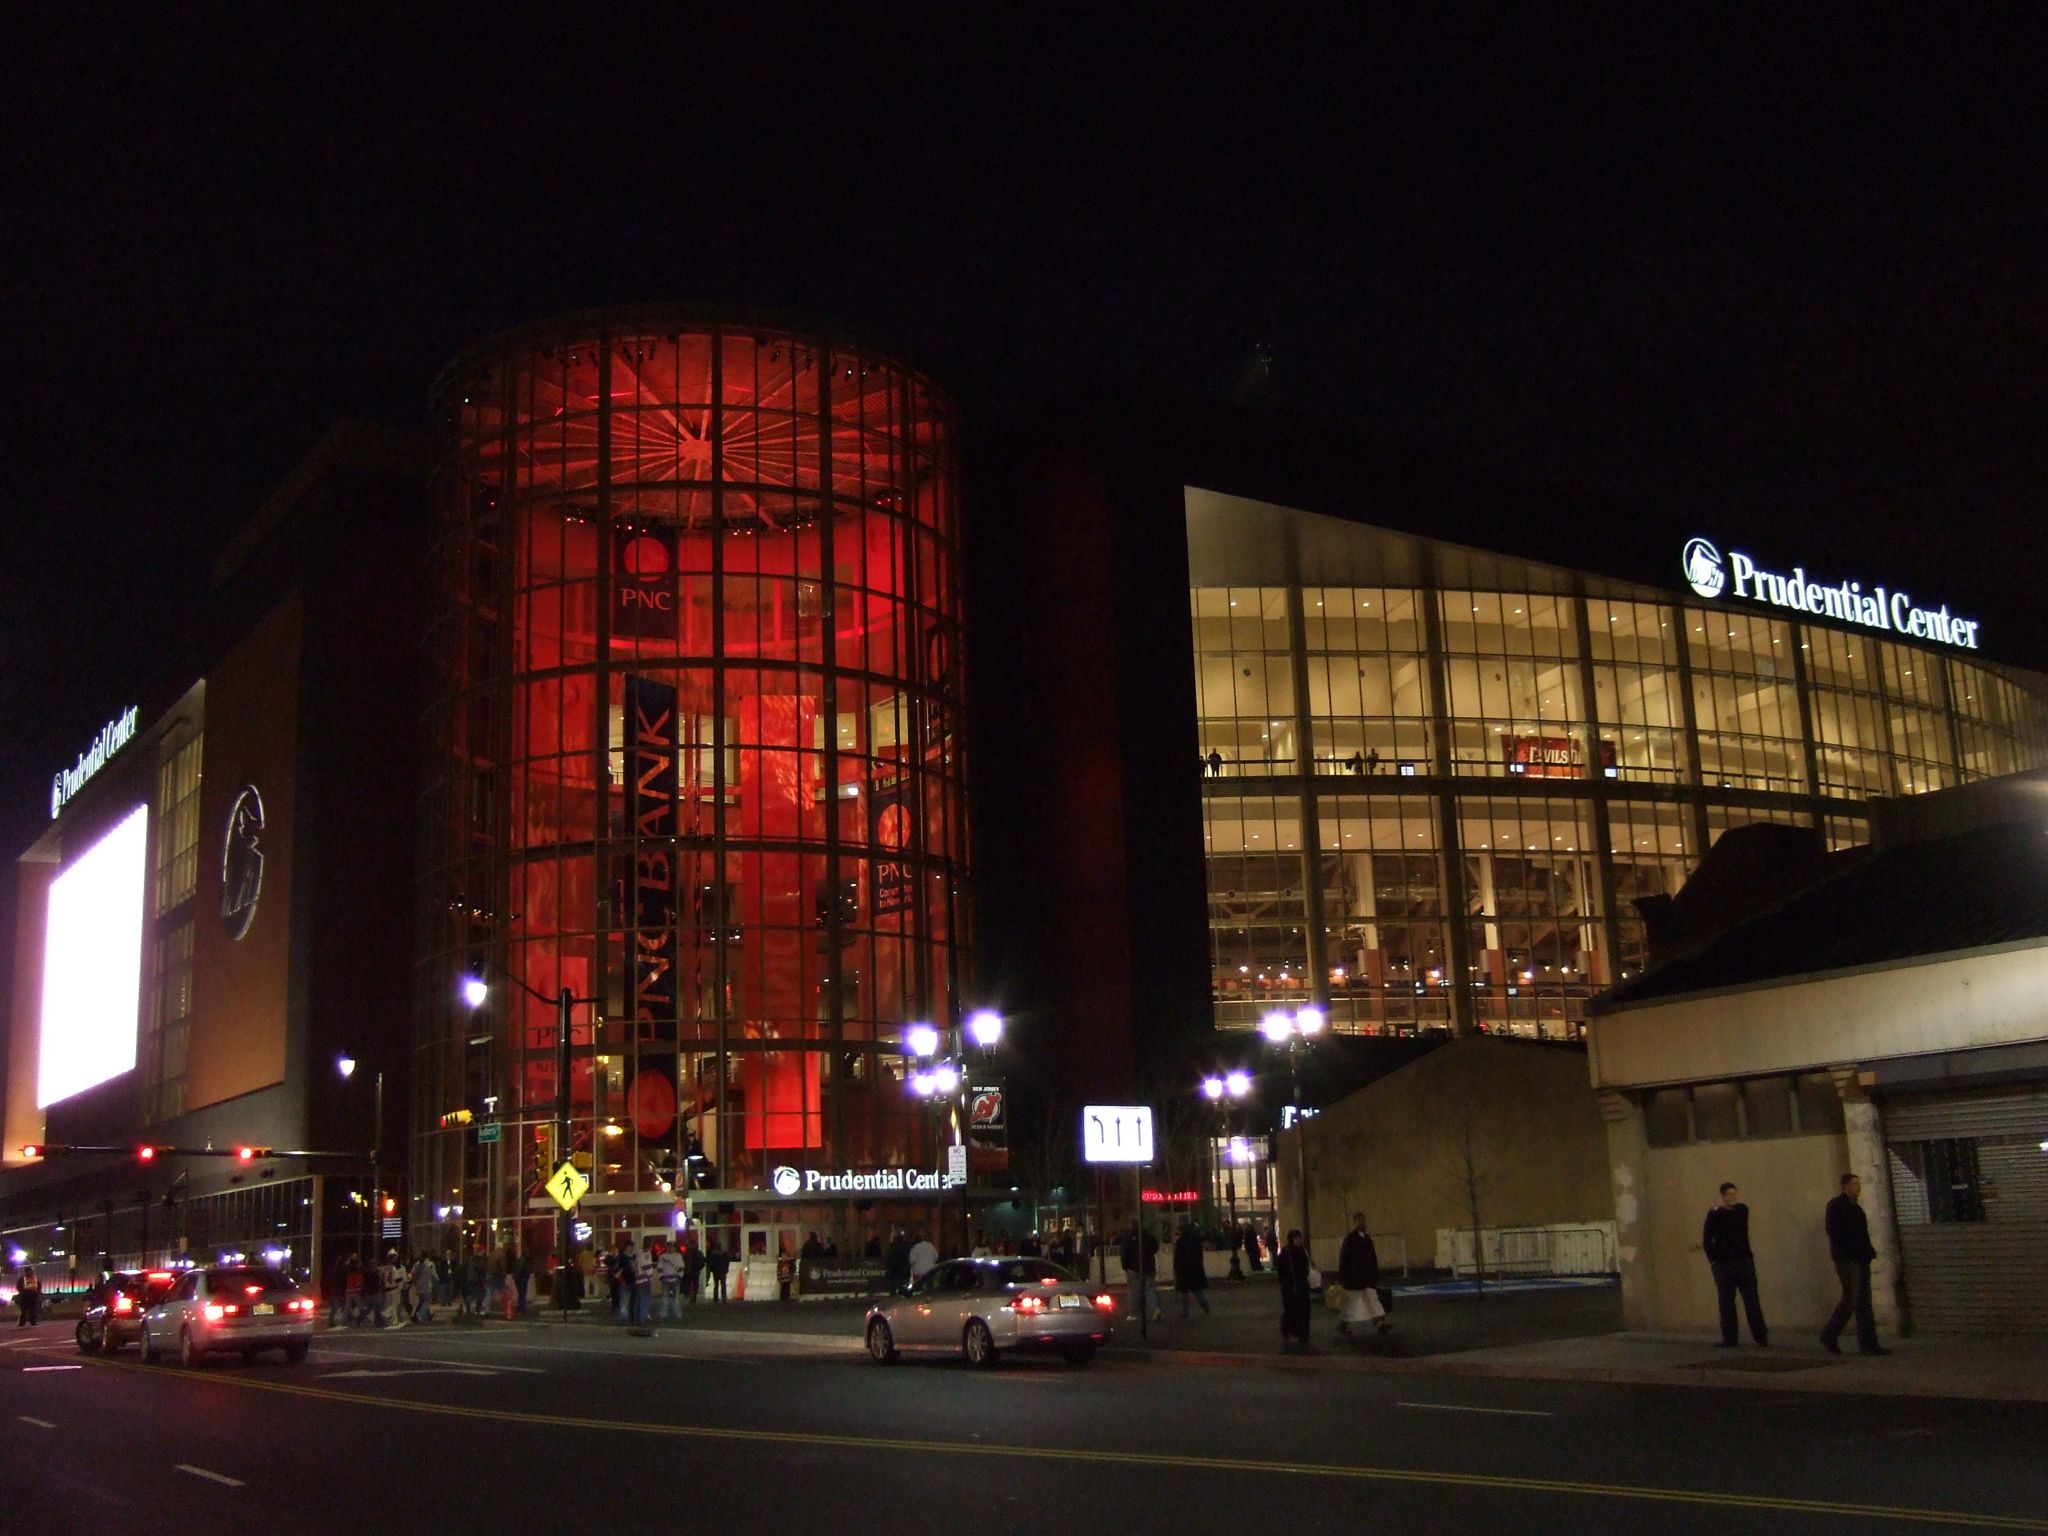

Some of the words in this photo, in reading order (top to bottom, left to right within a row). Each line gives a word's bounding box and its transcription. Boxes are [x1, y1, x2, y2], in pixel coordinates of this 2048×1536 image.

[620, 588, 672, 611] PNC
[1728, 550, 1891, 631] Prudential
[1889, 590, 1980, 650] Center
[62, 727, 107, 806] Prudential
[106, 704, 139, 759] Center
[636, 703, 672, 893] BANK
[804, 1168, 904, 1192] Prudential
